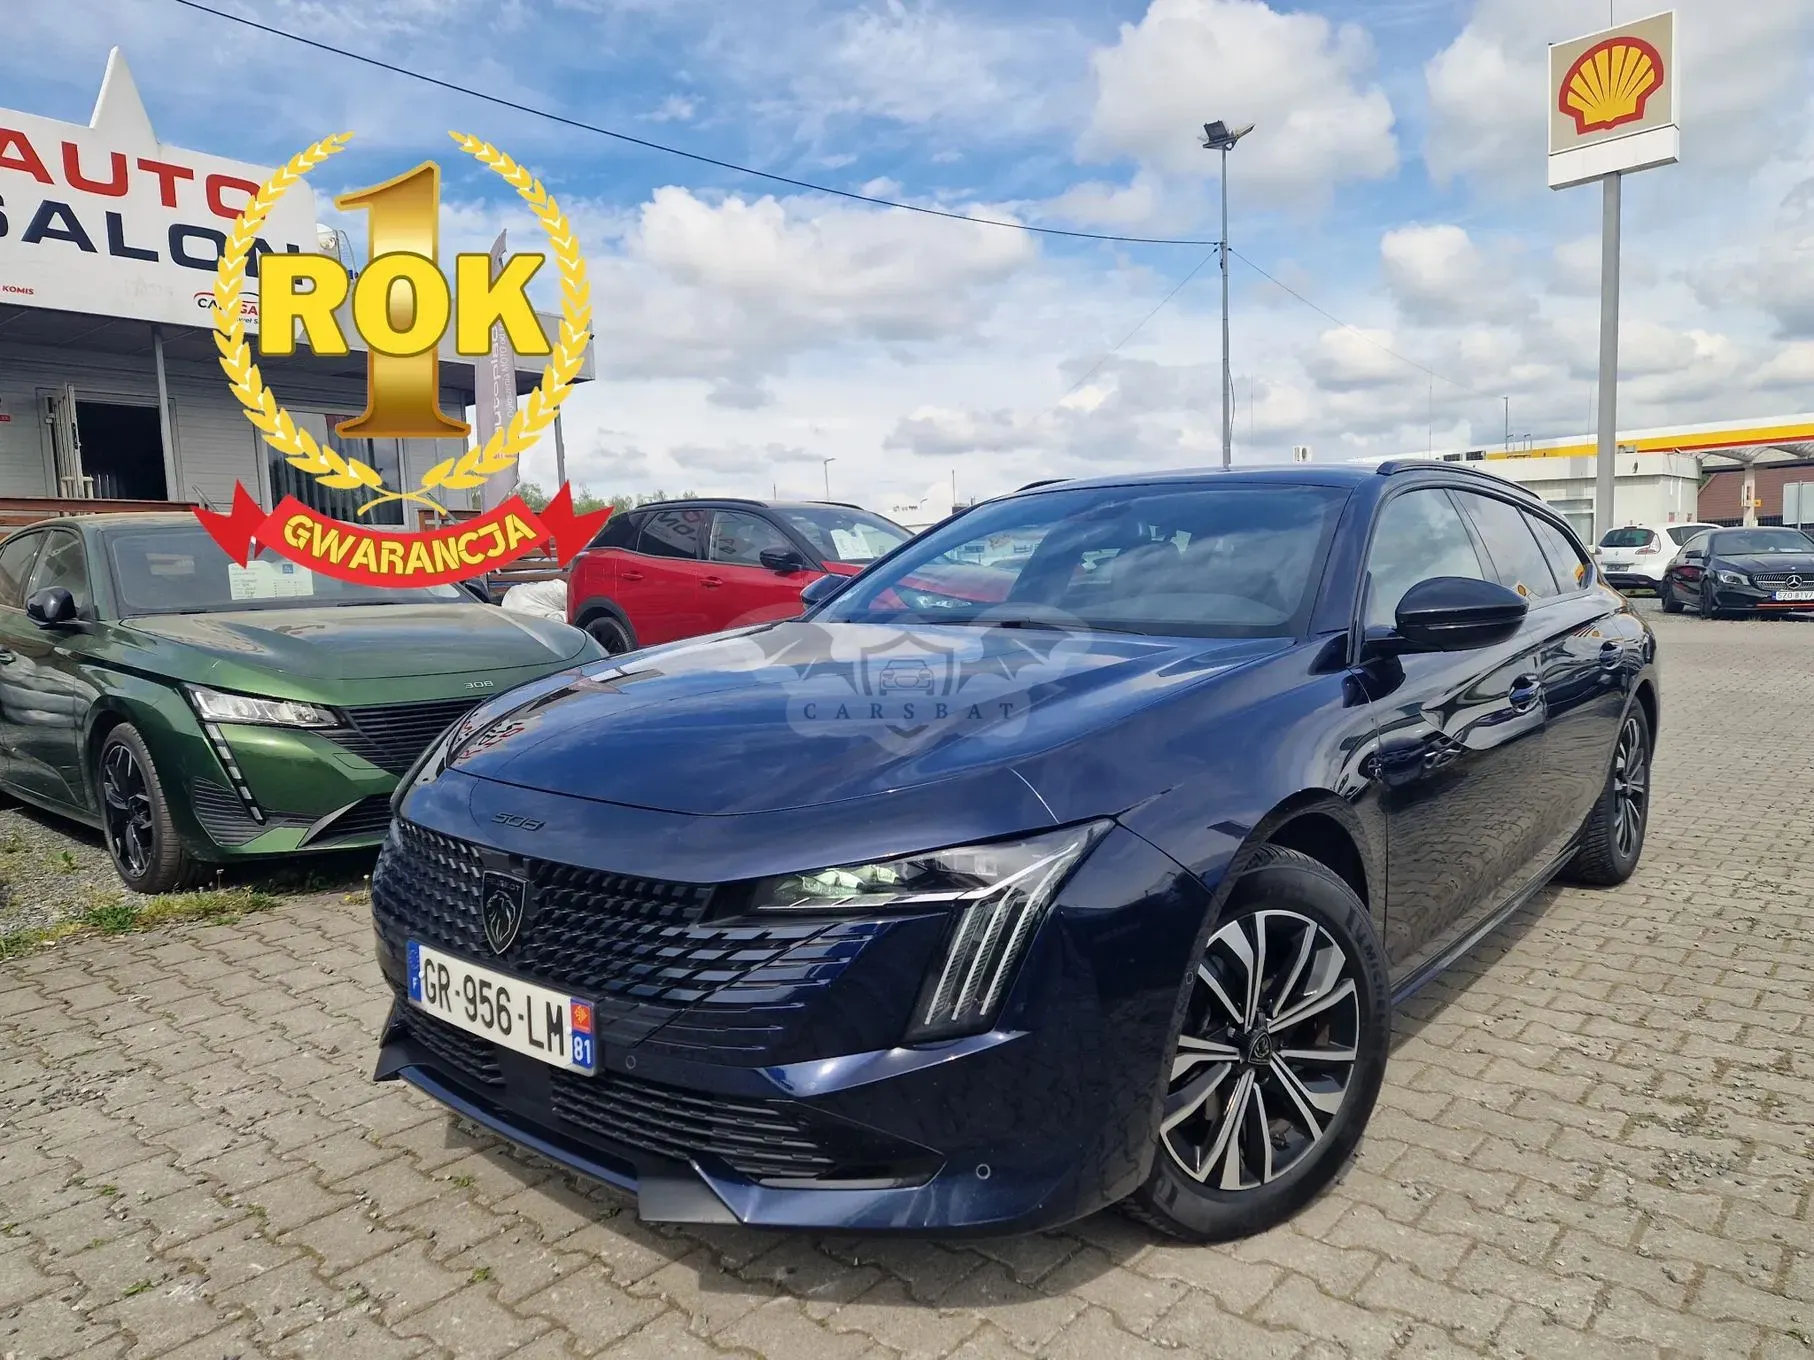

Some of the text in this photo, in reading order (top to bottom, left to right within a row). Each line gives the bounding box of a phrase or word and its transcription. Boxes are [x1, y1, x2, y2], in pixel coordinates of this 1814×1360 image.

[0, 128, 266, 220] AUTO
[2, 285, 34, 295] KOMIS
[463, 680, 494, 689] 308
[491, 811, 546, 832] 508
[423, 958, 565, 1057] GR-956-LM
[573, 1036, 591, 1065] 81
